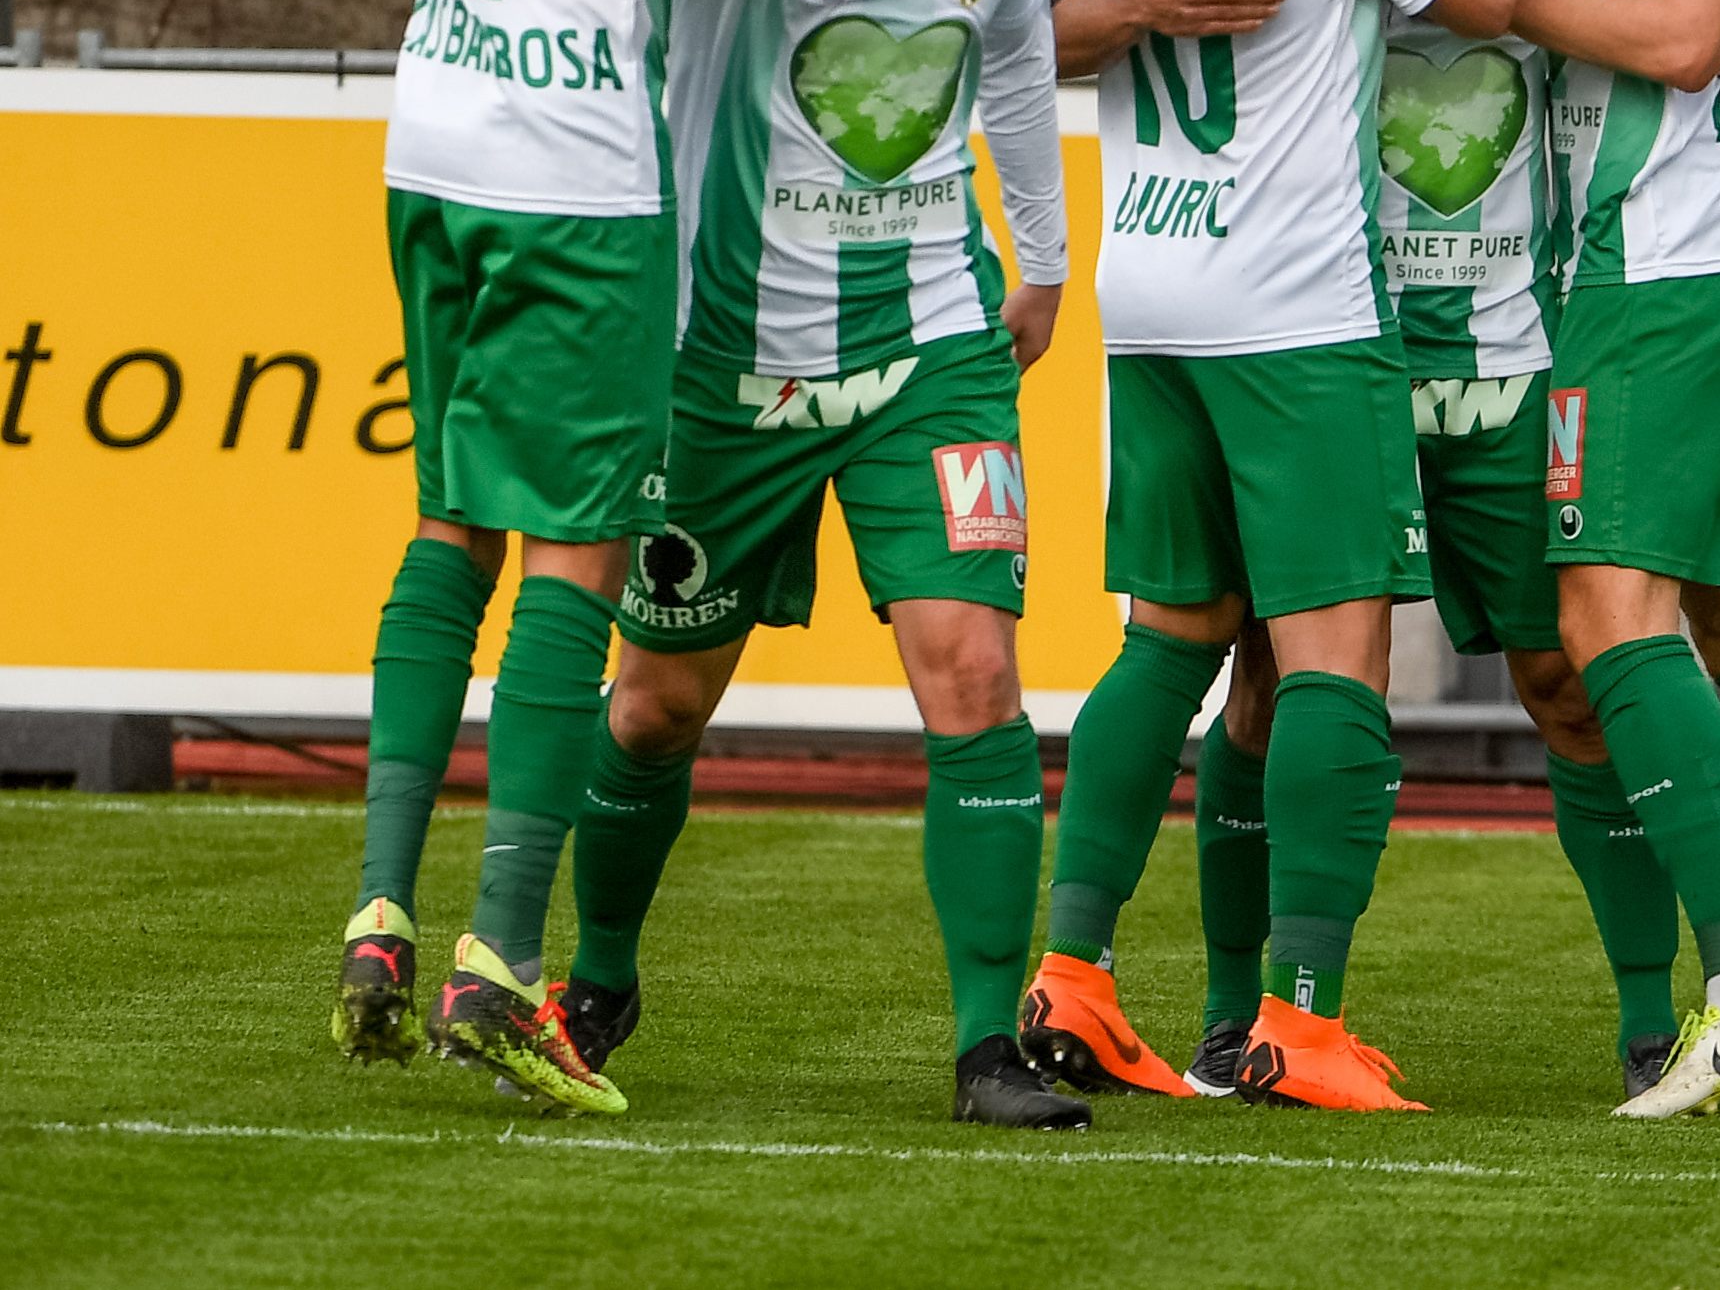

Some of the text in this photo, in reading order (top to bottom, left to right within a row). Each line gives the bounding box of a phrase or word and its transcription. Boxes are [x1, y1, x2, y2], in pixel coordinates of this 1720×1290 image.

[1561, 105, 1603, 128] PURE
[773, 180, 957, 216] PLANET PURE
[828, 216, 919, 237] Since 1999
[1381, 235, 1524, 258] ANET PURE
[1395, 263, 1487, 280] Since 1999
[1411, 373, 1536, 436] KW
[1547, 396, 1582, 467] N
[619, 583, 739, 629] MOHREN
